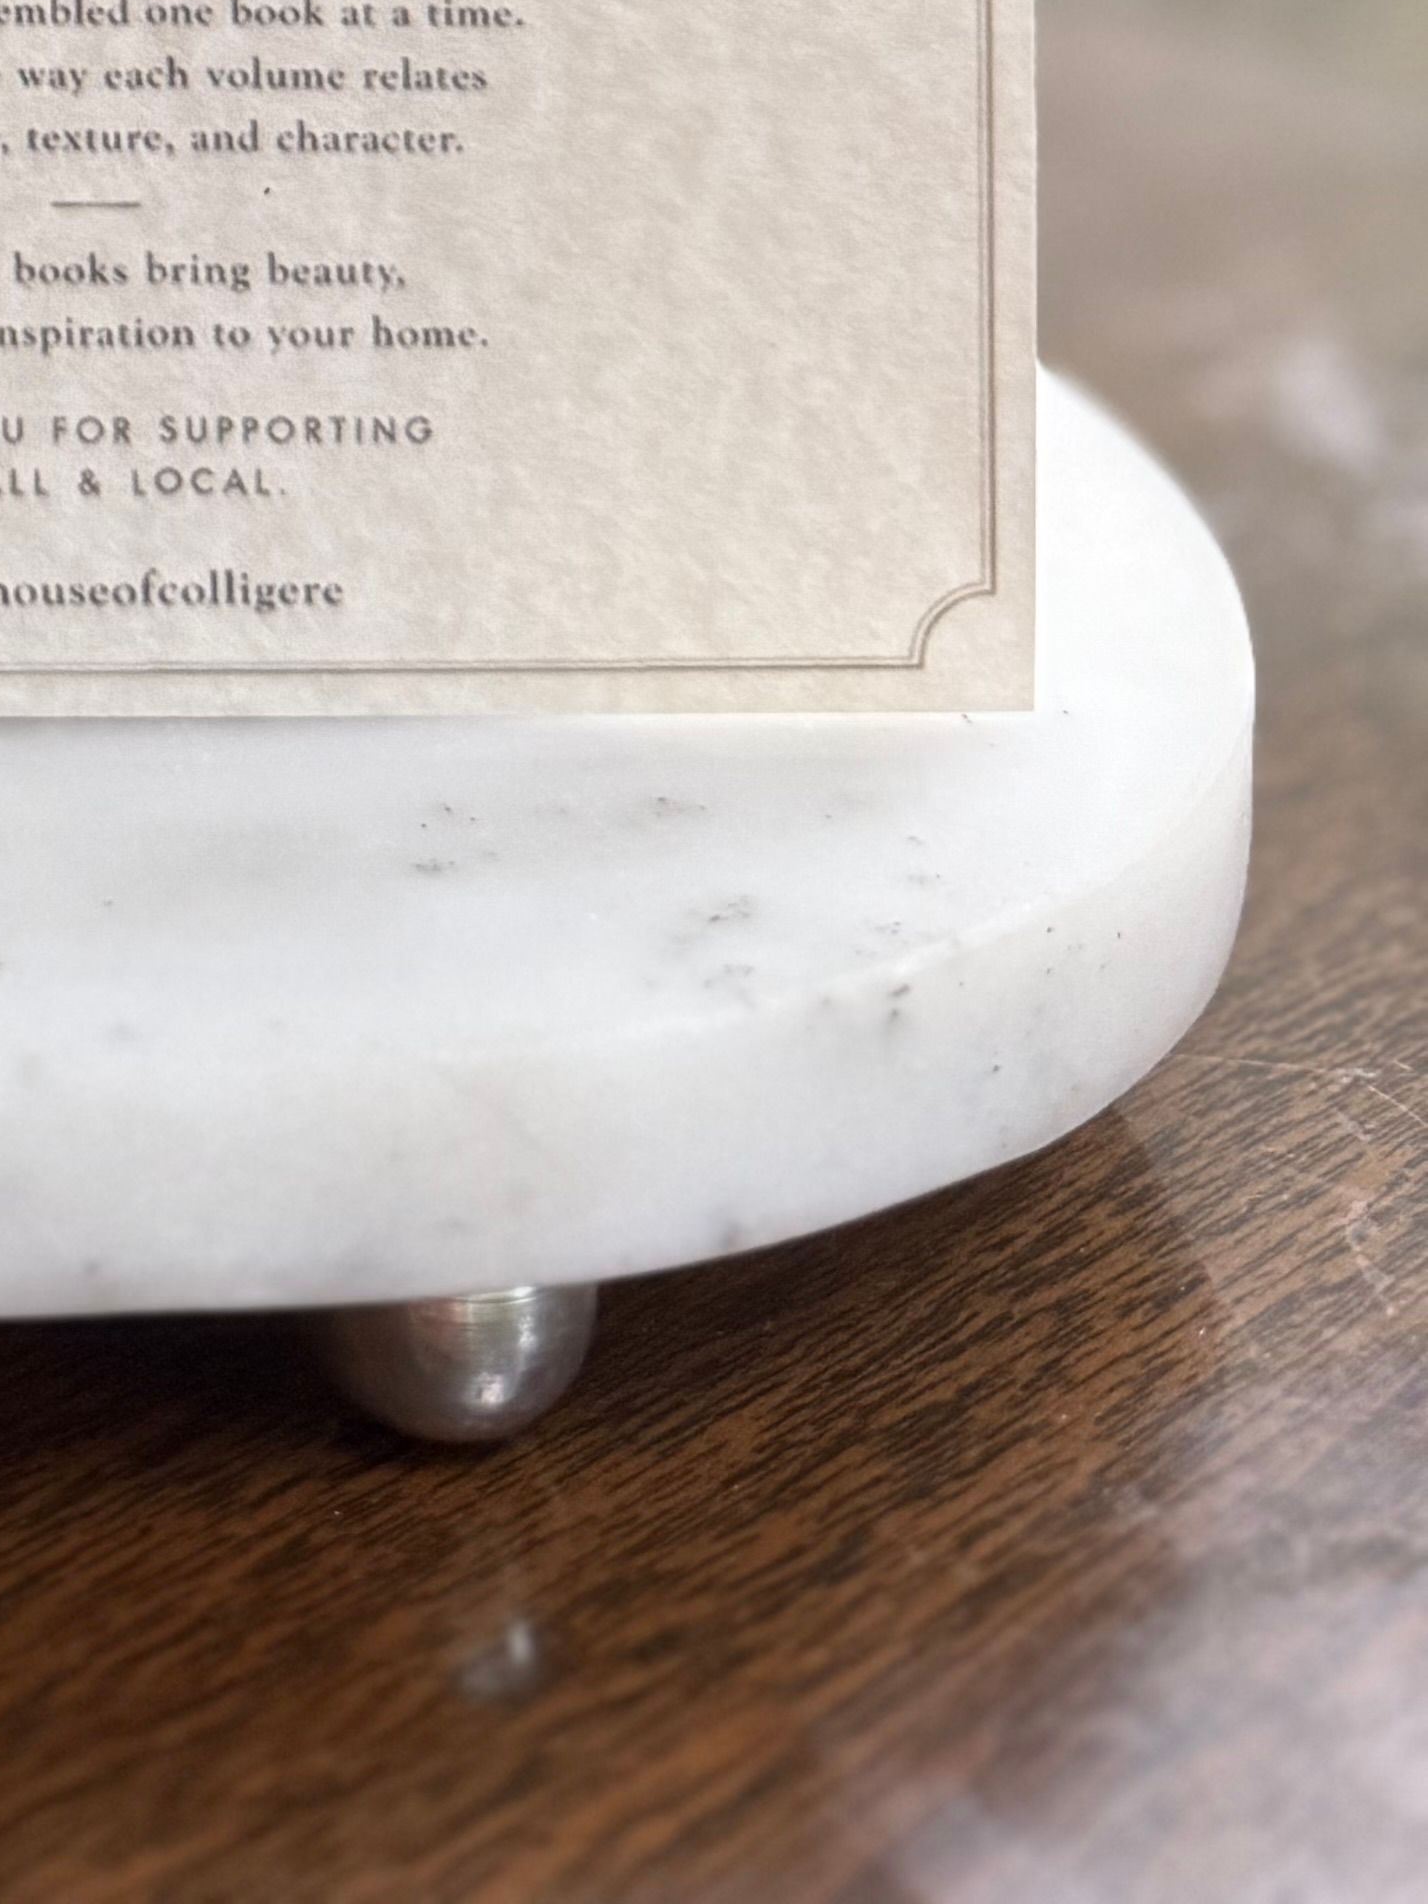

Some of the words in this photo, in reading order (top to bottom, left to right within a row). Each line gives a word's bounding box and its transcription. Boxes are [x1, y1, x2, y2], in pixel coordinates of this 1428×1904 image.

[143, 2, 215, 30] one
[339, 0, 377, 30] at
[391, 5, 413, 30] a
[15, 66, 88, 102] way
[102, 53, 190, 93] each
[204, 54, 346, 94] volume
[362, 55, 488, 94] relates
[25, 124, 176, 160] texture,
[189, 117, 261, 156] and
[275, 117, 465, 157] character.
[12, 249, 130, 291] books
[144, 249, 252, 298] bring
[265, 249, 407, 298] beauty,
[212, 320, 252, 352] to
[266, 325, 356, 362] your
[370, 313, 489, 352] home.
[51, 414, 133, 448] FOR
[158, 413, 435, 449] SUPPORTING
[76, 467, 103, 499] &
[130, 465, 287, 500] LOCAL.
